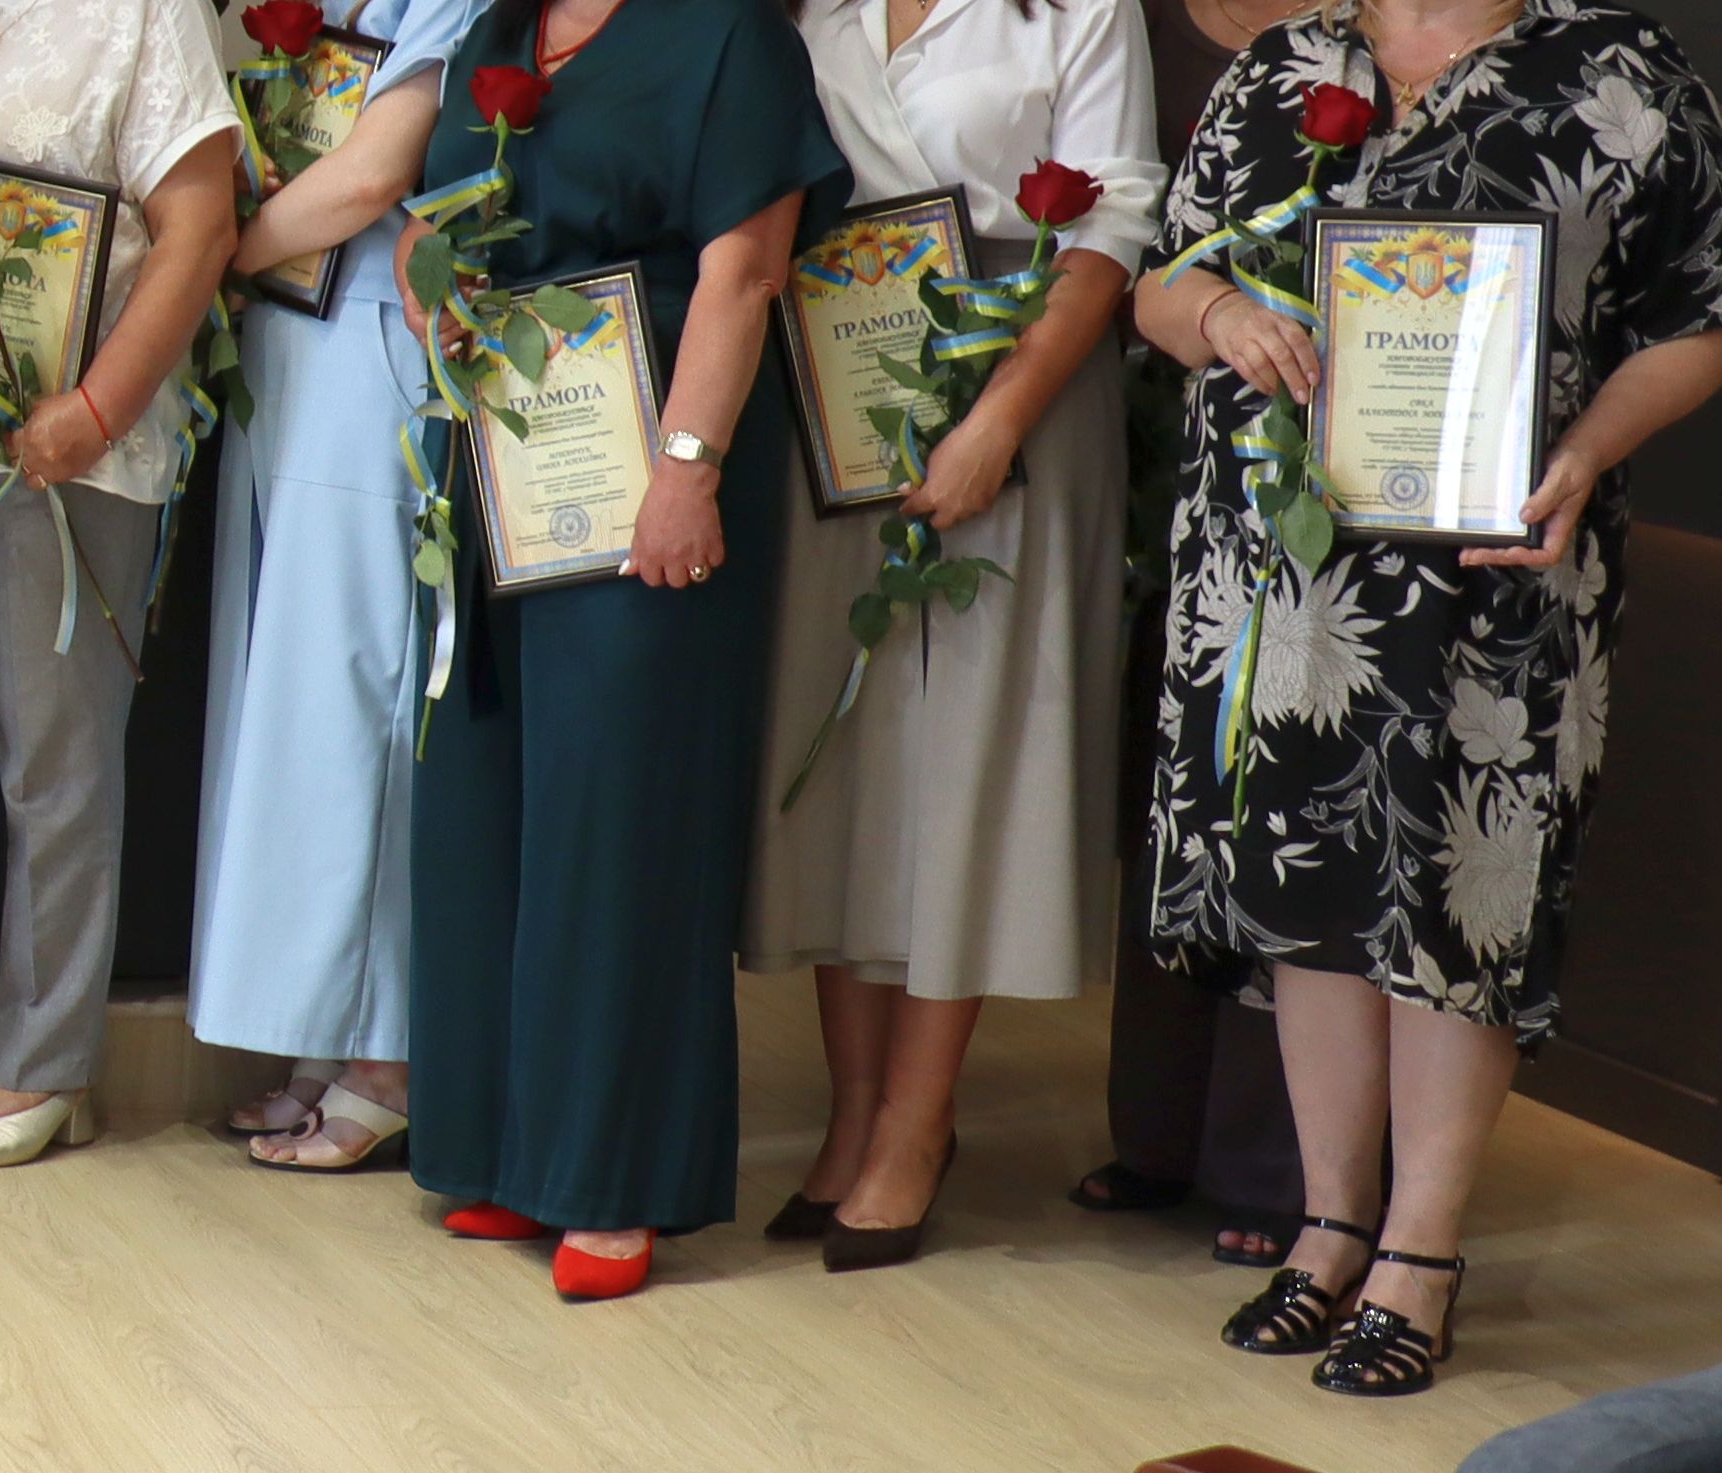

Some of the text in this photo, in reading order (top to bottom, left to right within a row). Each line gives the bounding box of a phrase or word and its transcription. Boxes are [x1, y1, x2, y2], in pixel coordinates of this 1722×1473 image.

[832, 307, 931, 341] ГРАМОТА
[1364, 331, 1478, 351] ГРАМОТ
[508, 382, 606, 413] ГРАМОТА
